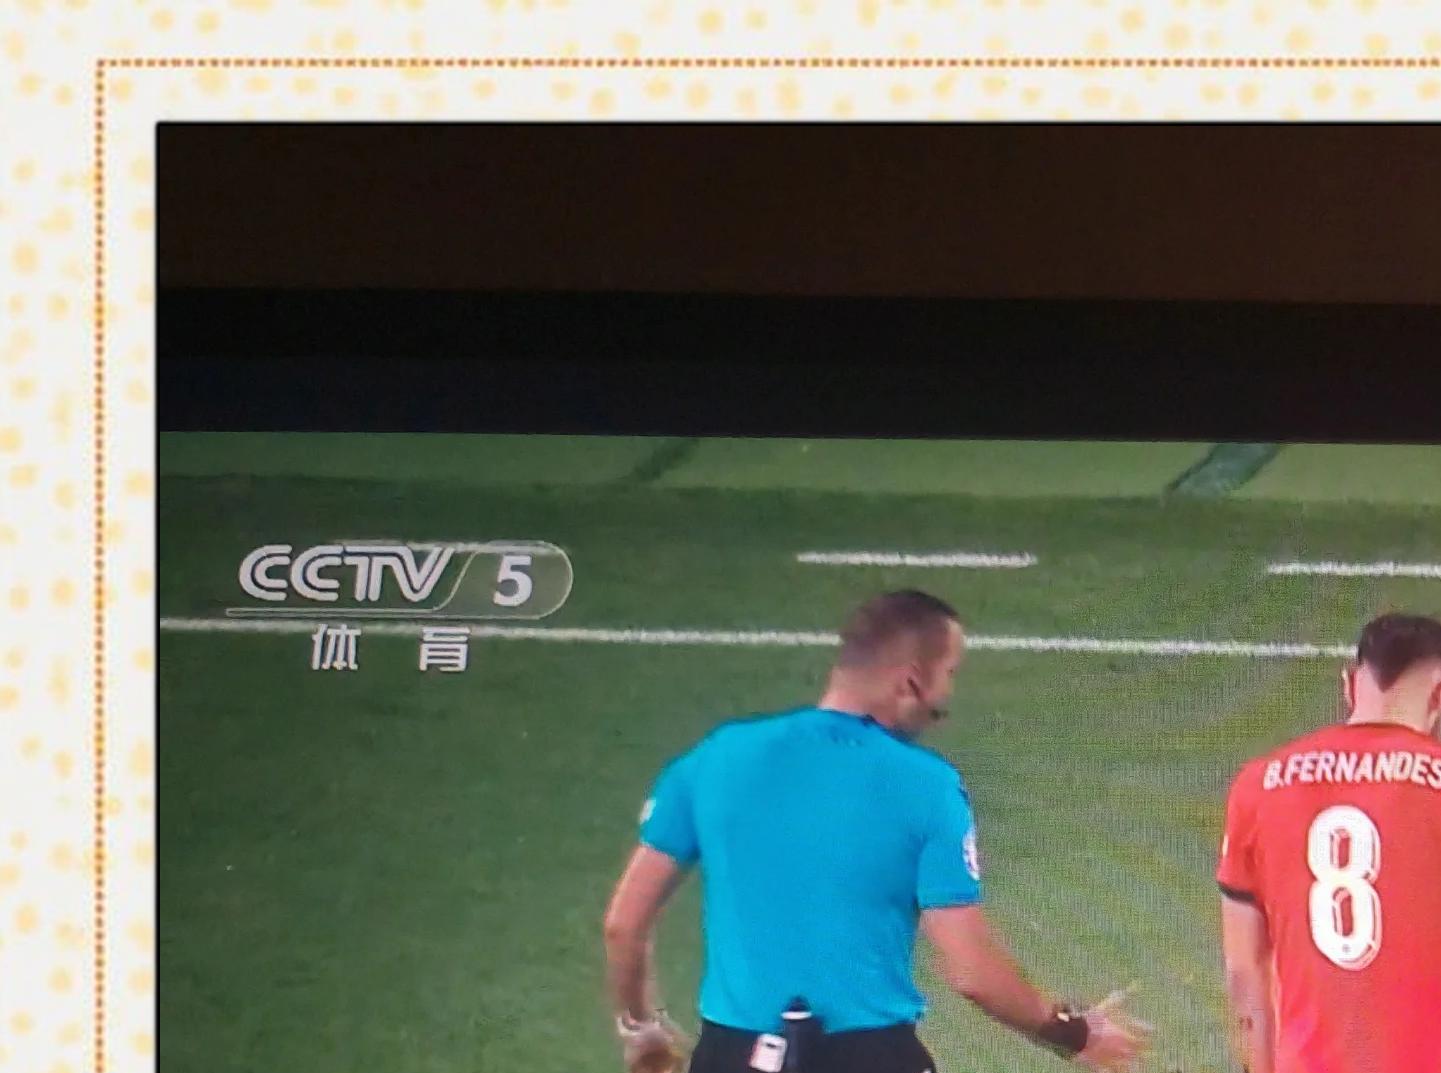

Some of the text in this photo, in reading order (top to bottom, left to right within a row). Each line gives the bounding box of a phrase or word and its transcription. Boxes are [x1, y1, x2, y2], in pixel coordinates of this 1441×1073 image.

[239, 544, 532, 606] CCTV 5
[311, 623, 471, 672] 体育
[1307, 804, 1383, 972] 8
